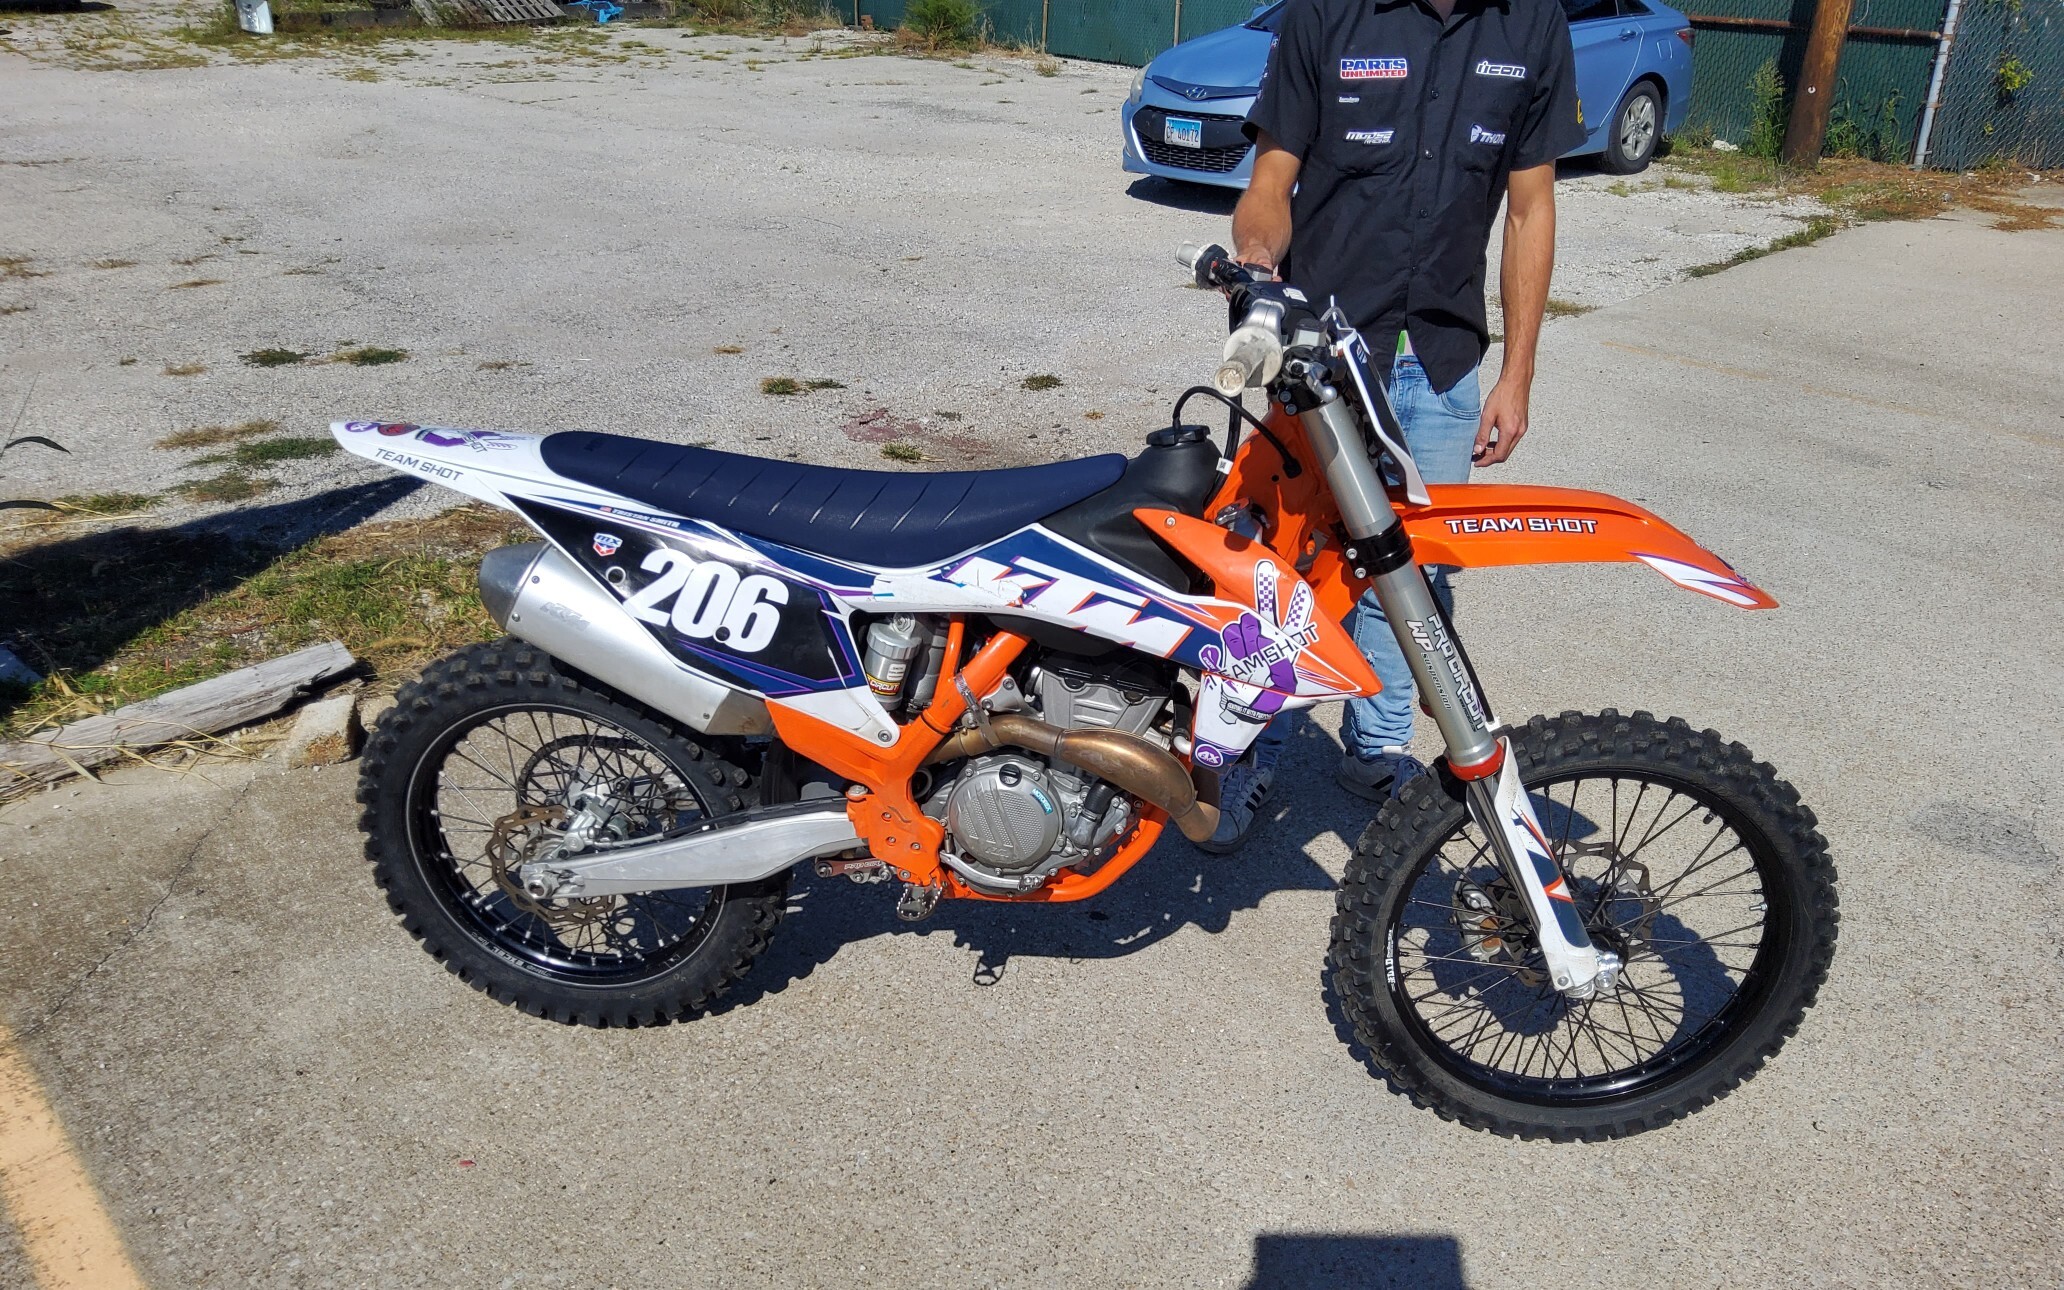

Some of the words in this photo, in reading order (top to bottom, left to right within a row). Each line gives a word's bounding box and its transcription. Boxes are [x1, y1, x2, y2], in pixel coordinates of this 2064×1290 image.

[1341, 60, 1406, 70] PARTS
[1341, 70, 1406, 78] UNLIMITED
[1178, 127, 1200, 142] 40172
[1480, 131, 1506, 144] THOR
[375, 448, 419, 468] TEAM
[419, 462, 464, 481] SHOT
[649, 517, 681, 528] SMITH
[1444, 518, 1523, 534] TEAM
[1529, 518, 1598, 534] SHOT
[622, 549, 789, 652] 206
[1427, 613, 1454, 660] PRO
[1406, 619, 1436, 652] WP
[1421, 652, 1452, 710] suspension
[870, 680, 899, 691] CIRCUIT
[616, 727, 650, 750] EXCEL
[491, 945, 525, 967] EXCEL
